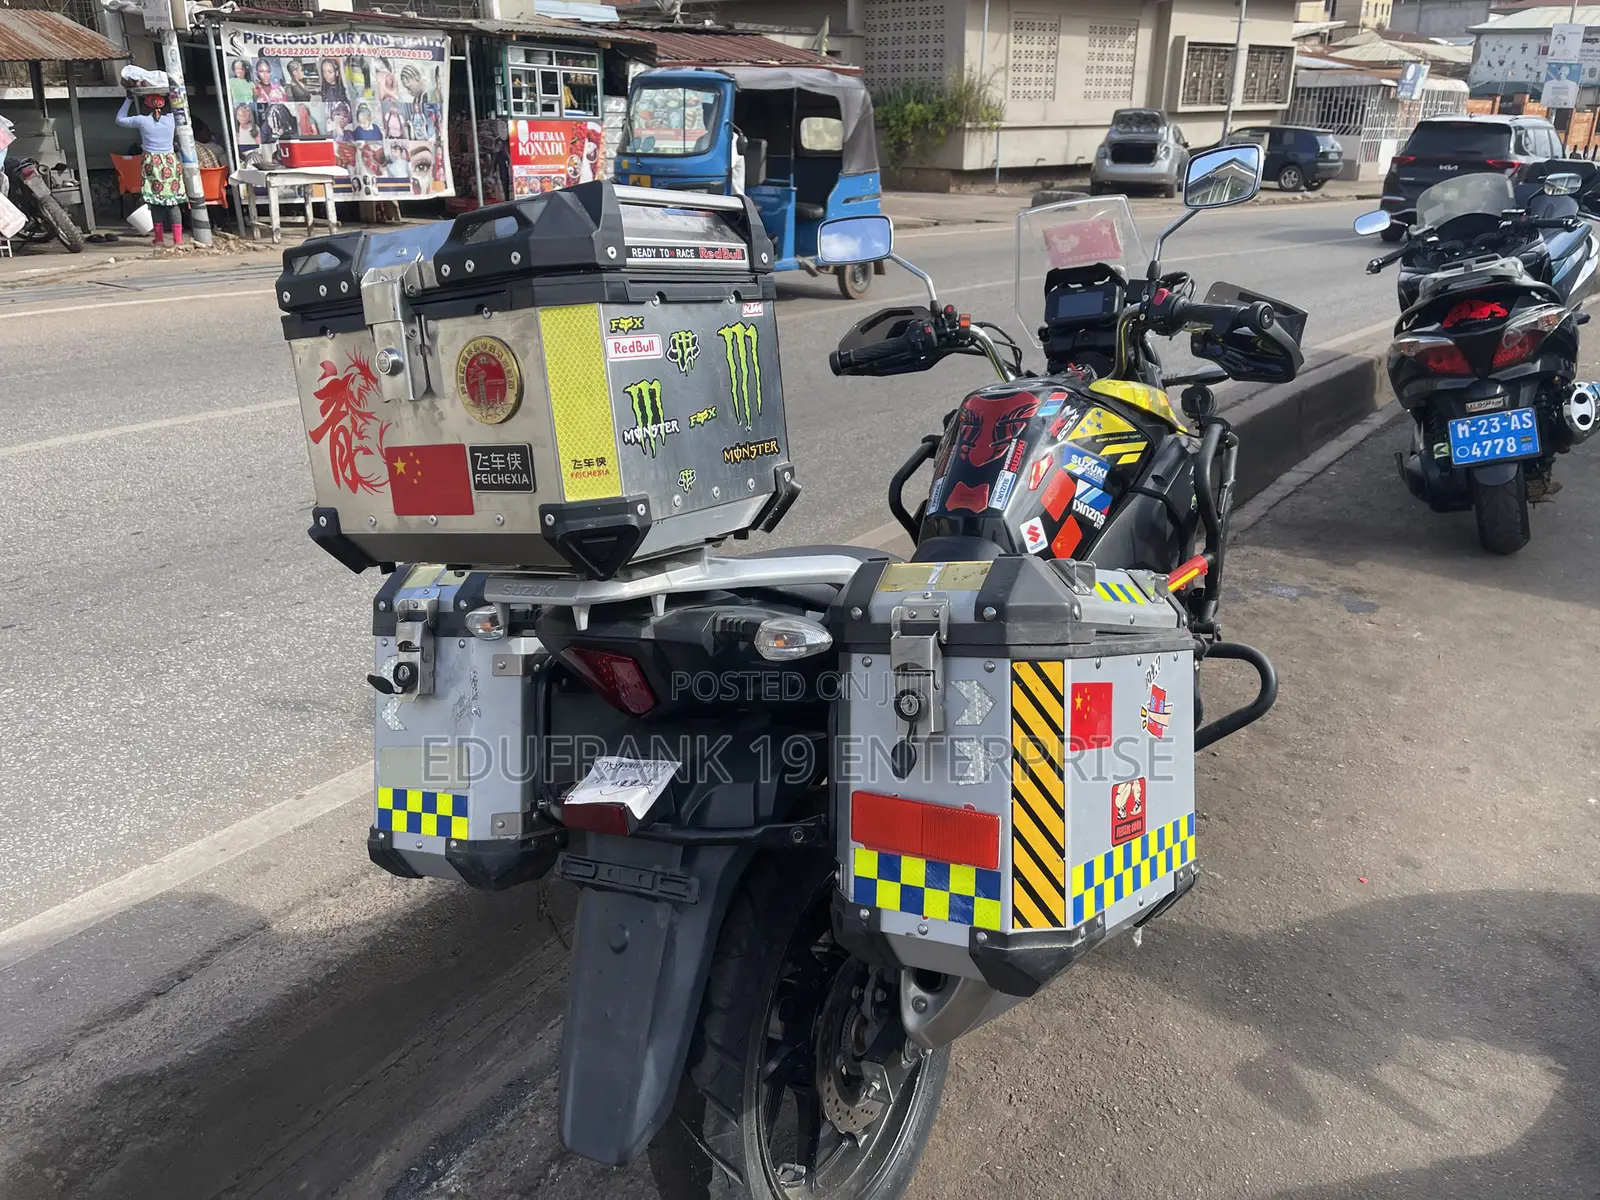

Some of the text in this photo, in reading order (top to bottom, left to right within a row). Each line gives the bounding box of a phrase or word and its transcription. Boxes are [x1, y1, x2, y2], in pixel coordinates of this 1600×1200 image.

[243, 32, 317, 45] PRECIOUS
[321, 33, 355, 46] HAIR
[360, 33, 390, 47] AND
[518, 141, 567, 156] KONADU
[631, 247, 695, 258] READY TO RACE
[743, 303, 763, 315] KTM
[1457, 413, 1533, 438] M-23-AS
[1471, 436, 1517, 458] 4778
[474, 452, 523, 471] 飞车侠
[571, 456, 607, 469] 飞车侠
[1010, 439, 1026, 472] SUZUKI
[570, 468, 610, 479] FEICHEXIA
[1071, 454, 1108, 478] SUZUKI
[475, 472, 530, 485] FEICHEXIA
[997, 478, 1010, 503] SUZUKI
[1072, 499, 1106, 526] SUZUKI
[1030, 540, 1046, 551] SUZUKI
[501, 583, 559, 597] SUZUKI
